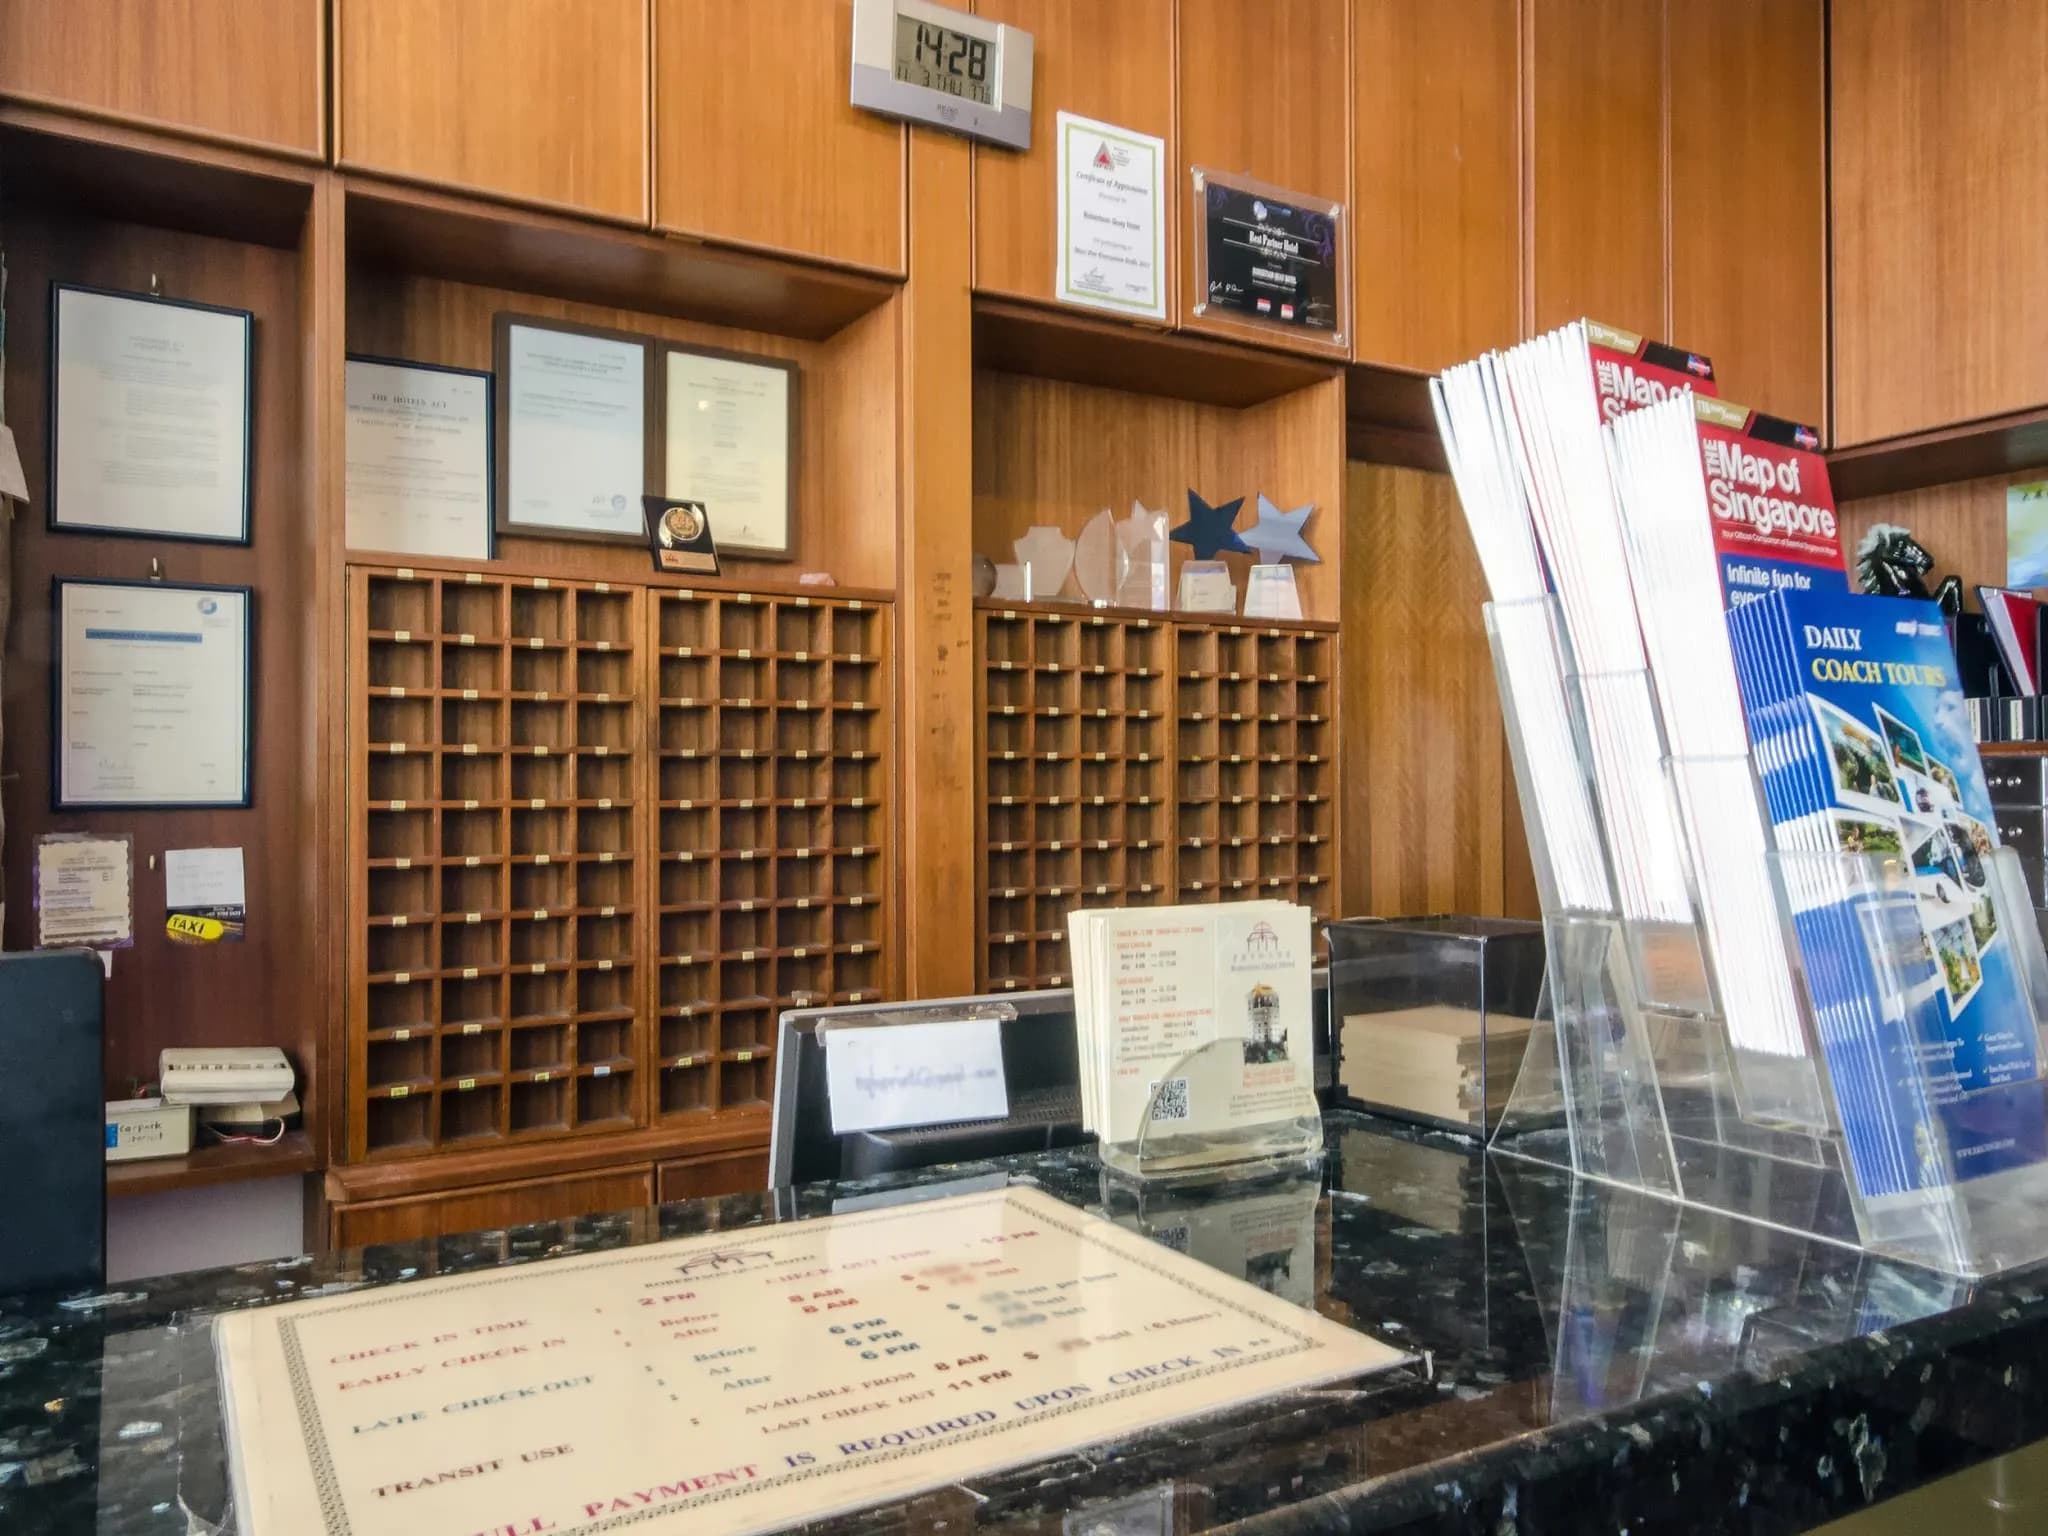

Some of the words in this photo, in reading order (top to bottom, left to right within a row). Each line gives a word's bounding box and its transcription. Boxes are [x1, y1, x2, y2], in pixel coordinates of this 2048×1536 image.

[915, 24, 987, 81] 14:28
[937, 73, 962, 97] THU
[1611, 362, 1668, 405] Map
[1702, 438, 1721, 476] THE
[1718, 440, 1776, 497] Map
[1777, 458, 1801, 495] of
[1709, 481, 1837, 538] Singapore
[1726, 563, 1770, 587] Infinite
[1772, 569, 1794, 589] fun
[1794, 571, 1812, 591] for
[1803, 624, 1862, 651] DAILY
[1811, 658, 1883, 683] COACH
[1883, 664, 1947, 688] TOURS
[172, 917, 206, 935] TAXI
[645, 1270, 730, 1289] ROBERTSON
[765, 1268, 832, 1285] CHECK
[1010, 1229, 1040, 1240] PM
[330, 1341, 420, 1365] CHECK
[433, 1332, 458, 1344] IN
[471, 1319, 531, 1335] TIME
[639, 1297, 656, 1307] 2
[663, 1291, 696, 1303] PM
[337, 1365, 427, 1391] EARLY
[441, 1345, 529, 1368] CHECK
[542, 1337, 567, 1349] IN
[659, 1313, 719, 1328] Before
[813, 1287, 845, 1299] AM
[673, 1325, 719, 1340] After
[801, 1305, 819, 1314] 8
[826, 1297, 860, 1310] AM
[844, 1337, 862, 1347] 6
[868, 1329, 903, 1343] PM
[352, 1411, 428, 1435] LATE
[441, 1388, 536, 1414] CHECK
[543, 1375, 595, 1392] OUT
[693, 1345, 758, 1363] Before
[828, 1325, 847, 1334] 6
[852, 1318, 888, 1330] PM
[723, 1375, 773, 1391] After
[860, 1350, 879, 1361] 6
[884, 1342, 921, 1355] PM
[371, 1459, 504, 1498] TRANSIT
[520, 1444, 575, 1463] USE
[745, 1383, 856, 1415] AVAILABLE
[861, 1371, 916, 1391] FROM
[934, 1361, 951, 1372] 8
[956, 1353, 990, 1367] AM
[761, 1416, 811, 1435] LAST
[821, 1400, 892, 1422] CHECK
[897, 1389, 936, 1404] OUT
[947, 1379, 974, 1392] 11
[978, 1369, 1013, 1385] PM
[581, 1463, 760, 1517] PAYMENT
[784, 1451, 818, 1468] IS
[838, 1408, 998, 1456] REQUIRED
[1014, 1381, 1093, 1413] UPON
[1107, 1355, 1201, 1387] CHECK
[1211, 1344, 1244, 1359] IN
